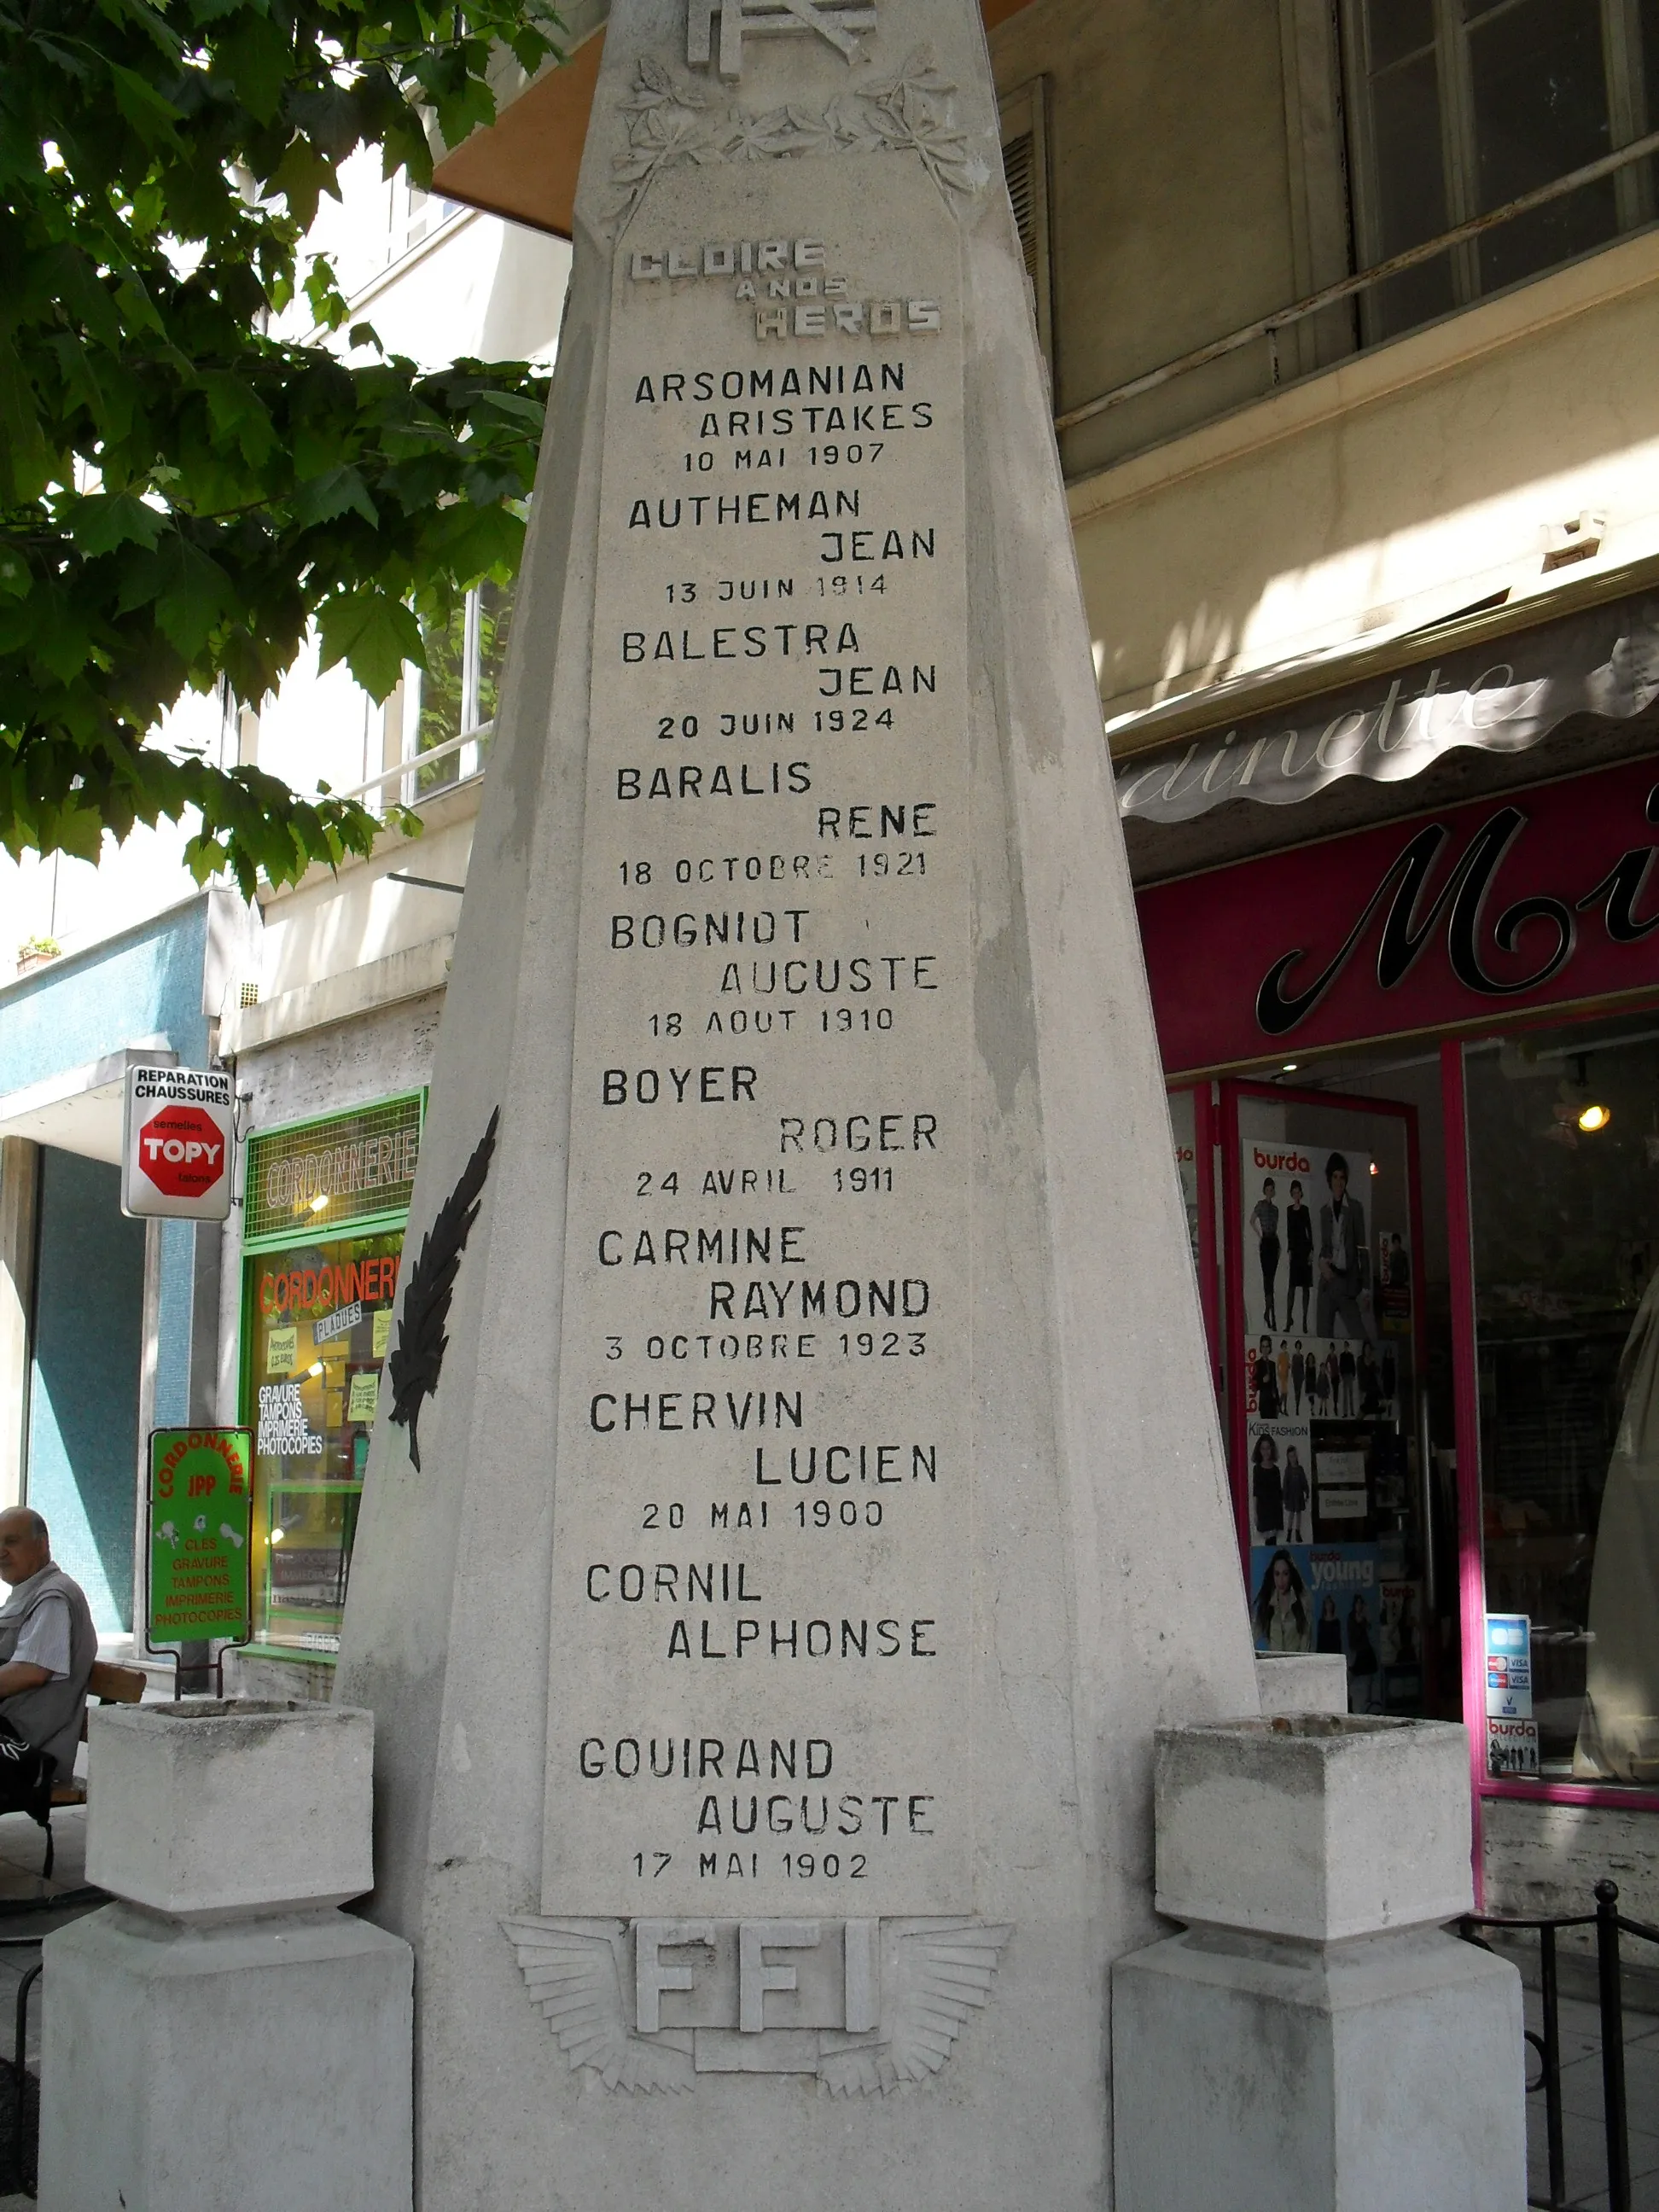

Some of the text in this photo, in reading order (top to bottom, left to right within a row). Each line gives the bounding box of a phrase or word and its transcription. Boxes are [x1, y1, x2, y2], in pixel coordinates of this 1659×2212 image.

[770, 276, 848, 298] NOS
[756, 300, 940, 340] HEROS
[635, 363, 903, 404] ARSOMANIAN
[700, 403, 932, 438] ARISTAKES
[684, 443, 883, 472] 10 MAI 1907
[628, 489, 860, 529] AUTHEMAN
[821, 528, 934, 562] JEAN
[667, 573, 888, 603] 13 JUIN 1914
[623, 623, 859, 663] BALESTRA
[819, 665, 935, 696] JEAN
[658, 708, 894, 739] 20 JUIN 1924
[1113, 664, 1547, 808] dinette
[618, 762, 812, 800] BARALIS
[818, 803, 937, 839] RENE
[620, 852, 925, 885] 18 OCTOBRE 1921
[611, 911, 809, 949] BOGNIOT
[649, 1008, 893, 1037] 18 AOUT 1910
[137, 1069, 228, 1090] REPARATION
[602, 1064, 757, 1105] BOYER
[135, 1086, 230, 1105] CHAUSSURES
[154, 1120, 202, 1132] semelles
[781, 1115, 937, 1153] ROGER
[144, 1138, 220, 1164] TOPY
[1254, 1147, 1310, 1173] burda
[178, 1173, 212, 1184] talons
[266, 1128, 416, 1208] CORDONNERIE
[637, 1167, 892, 1196] 24 AVRIL 1911
[598, 1227, 806, 1266] CARMINE
[710, 1279, 930, 1319] RAYMOND
[317, 1302, 361, 1342] PLAQUES
[605, 1332, 926, 1360] 3 OCTOBRE 1923
[259, 1383, 300, 1403] GRAVURE
[259, 1401, 302, 1421] TAMPONS
[590, 1391, 801, 1433] CHERVIN
[258, 1419, 308, 1437] IMPRIMERIE
[1271, 1426, 1308, 1436] FASHION
[258, 1435, 323, 1455] PHOTOCOPIES
[159, 1433, 244, 1498] CORDONNERIE
[756, 1445, 935, 1485] LUCIEN
[188, 1475, 217, 1497] JPP
[643, 1500, 882, 1529] 20 MAI 1900
[185, 1539, 217, 1551] CLES
[172, 1556, 228, 1571] GRAVURE
[1310, 1559, 1374, 1591] young
[172, 1574, 230, 1589] TAMPONS
[587, 1563, 761, 1603] CORNIL
[165, 1592, 234, 1608] IMPRIMERIE
[155, 1608, 242, 1626] PHOTOCOPIES
[667, 1619, 936, 1659] ALPHONSE
[1511, 1659, 1528, 1668] VISA
[1511, 1675, 1528, 1684] VISA
[1488, 1719, 1536, 1738] burda
[580, 1738, 832, 1779] GOUIRAND
[697, 1795, 934, 1836] AUGUSTE
[633, 1852, 868, 1878] 17 MAI 1902
[637, 1920, 880, 2033] FFI
